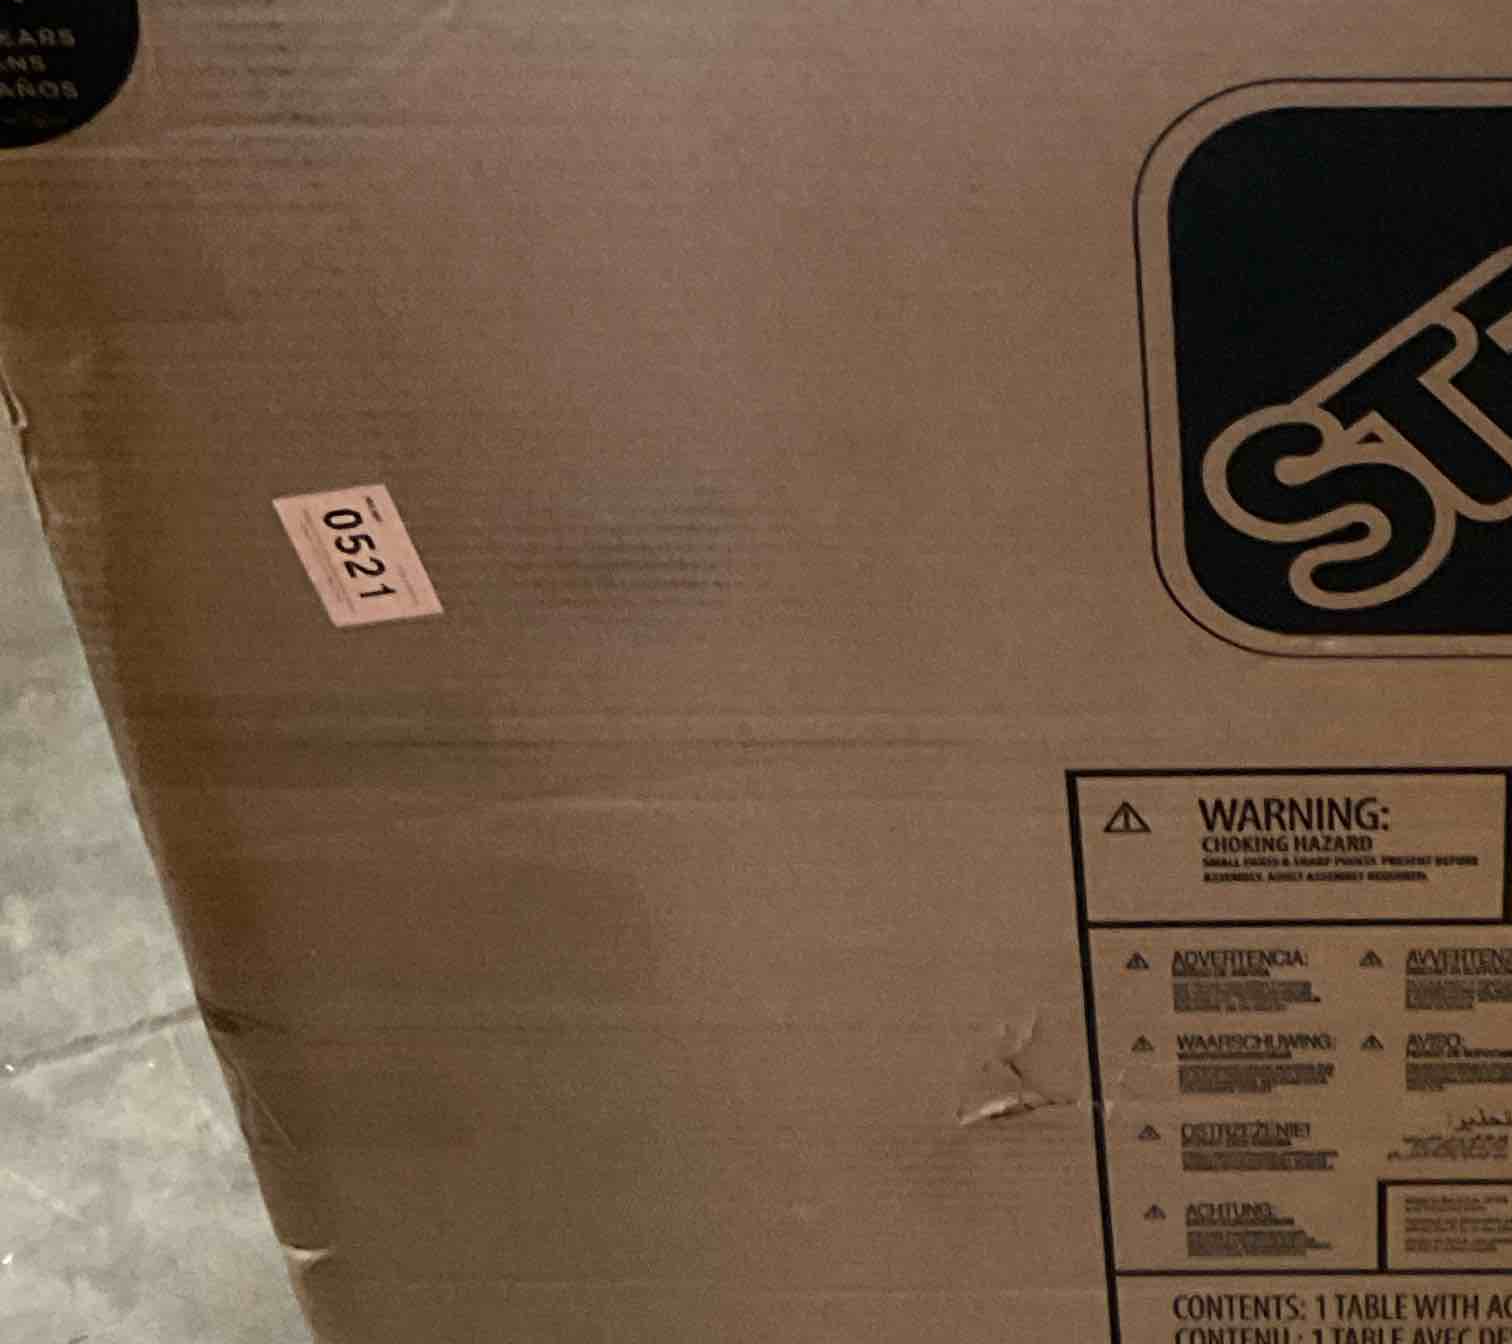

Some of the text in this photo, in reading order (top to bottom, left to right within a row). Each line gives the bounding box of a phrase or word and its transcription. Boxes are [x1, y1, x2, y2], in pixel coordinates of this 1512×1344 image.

[322, 508, 398, 599] 0521
[1199, 796, 1391, 833] WARNING:
[1201, 834, 1374, 854] CHOKING HAZARD
[1172, 1293, 1306, 1321] CONTENTS:
[1315, 1294, 1327, 1320] 1
[1334, 1294, 1407, 1320] TABLE
[1413, 1293, 1479, 1320] WITH
